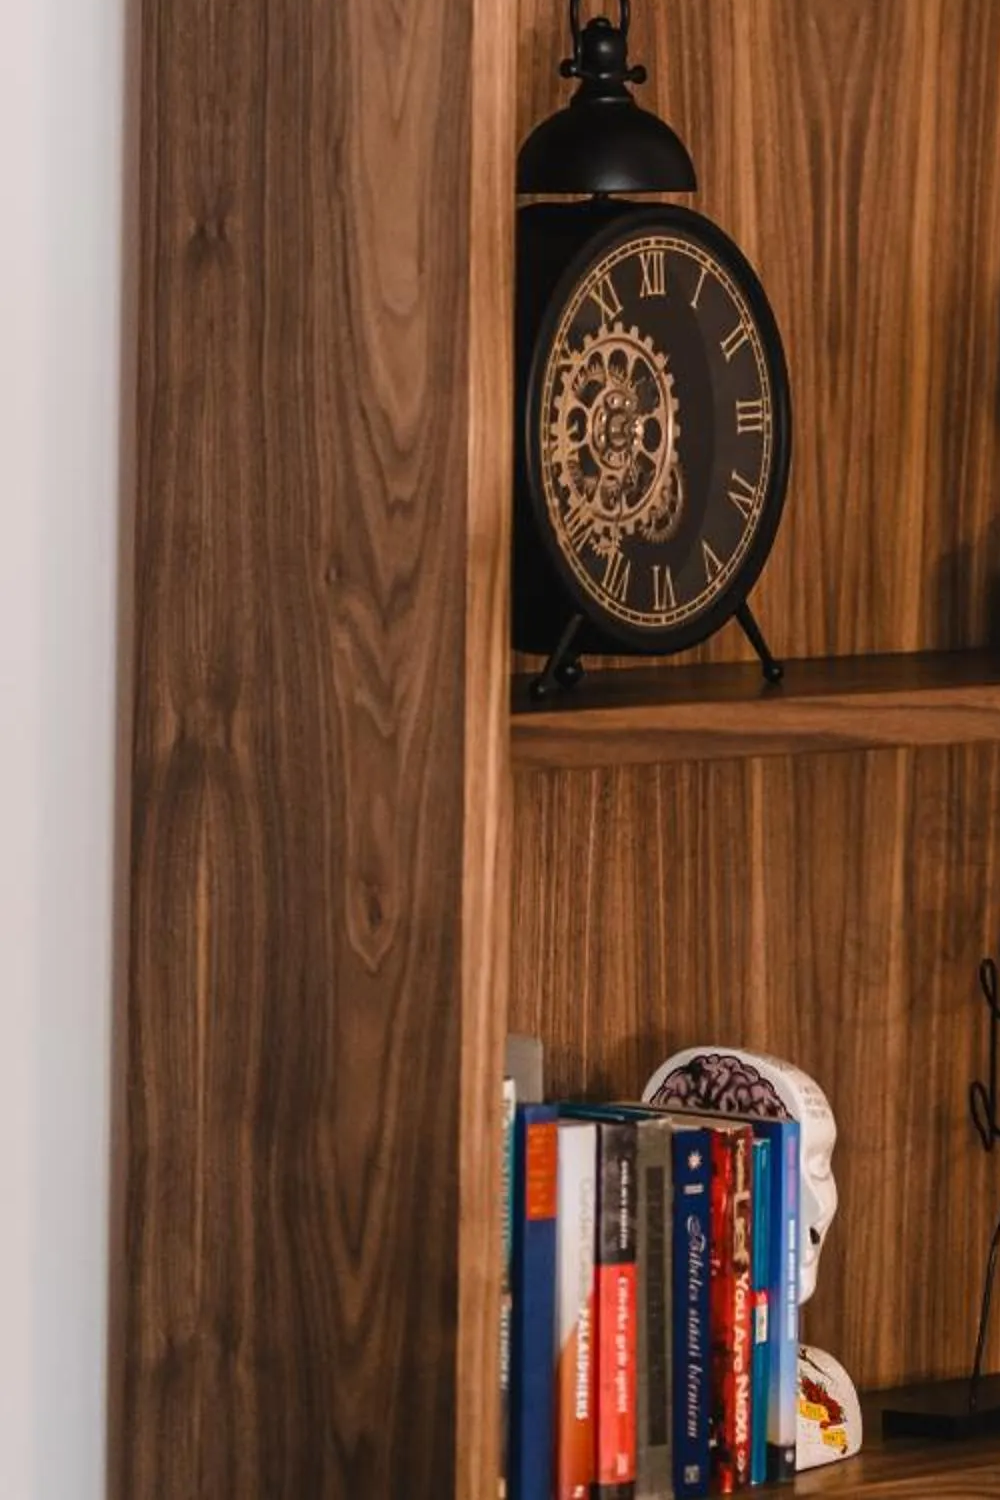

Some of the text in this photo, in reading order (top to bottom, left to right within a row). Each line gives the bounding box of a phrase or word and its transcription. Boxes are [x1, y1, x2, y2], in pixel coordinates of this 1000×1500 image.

[639, 252, 666, 298] XII
[736, 400, 764, 435] III
[735, 1272, 750, 1323] You
[733, 1324, 748, 1375] Are
